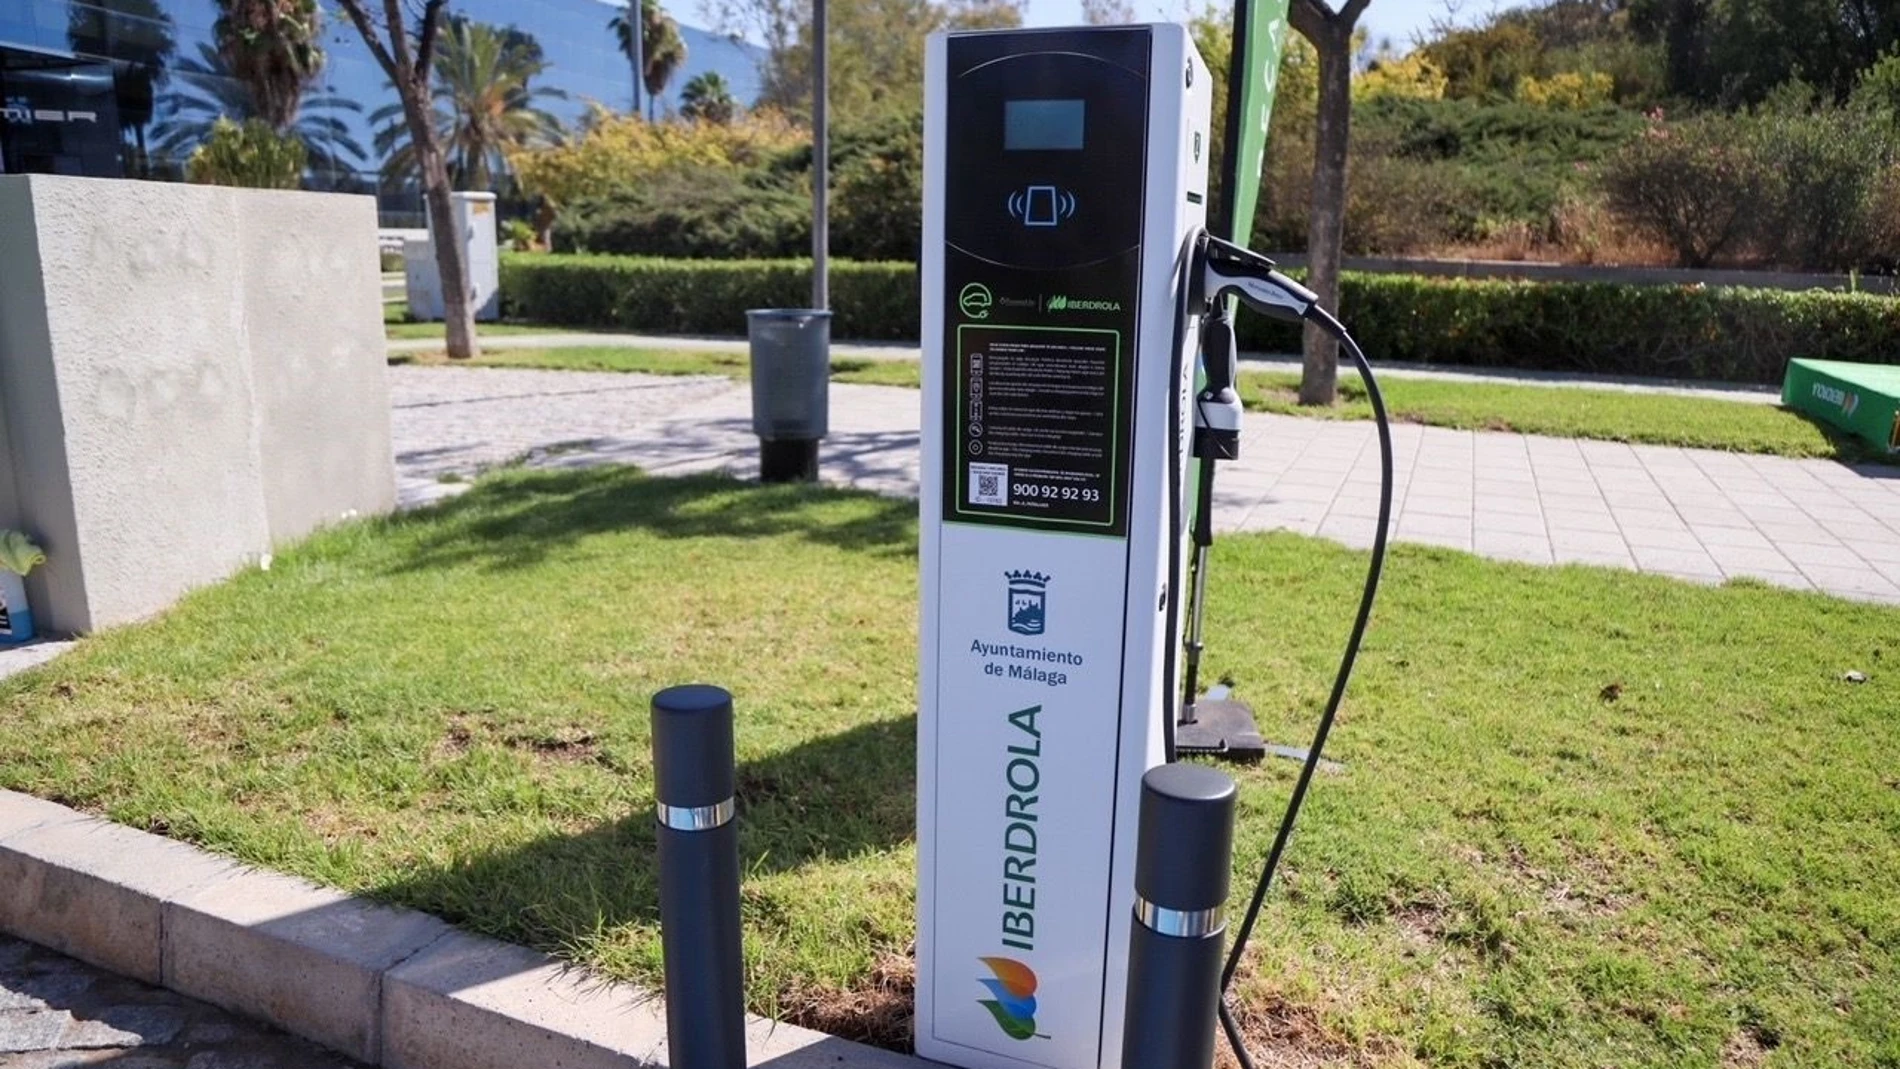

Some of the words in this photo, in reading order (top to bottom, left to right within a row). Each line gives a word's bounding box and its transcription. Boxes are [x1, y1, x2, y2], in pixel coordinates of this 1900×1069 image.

[1067, 299, 1121, 311] IBERDROLA
[1012, 483, 1039, 497] 900
[1041, 485, 1058, 498] 92
[1061, 487, 1079, 500] 92
[1081, 488, 1100, 502] 93
[970, 639, 1083, 666] Ayuntamiento
[984, 662, 1003, 676] de
[1008, 664, 1067, 686] Málaga
[1002, 704, 1042, 951] IBERDROLA
